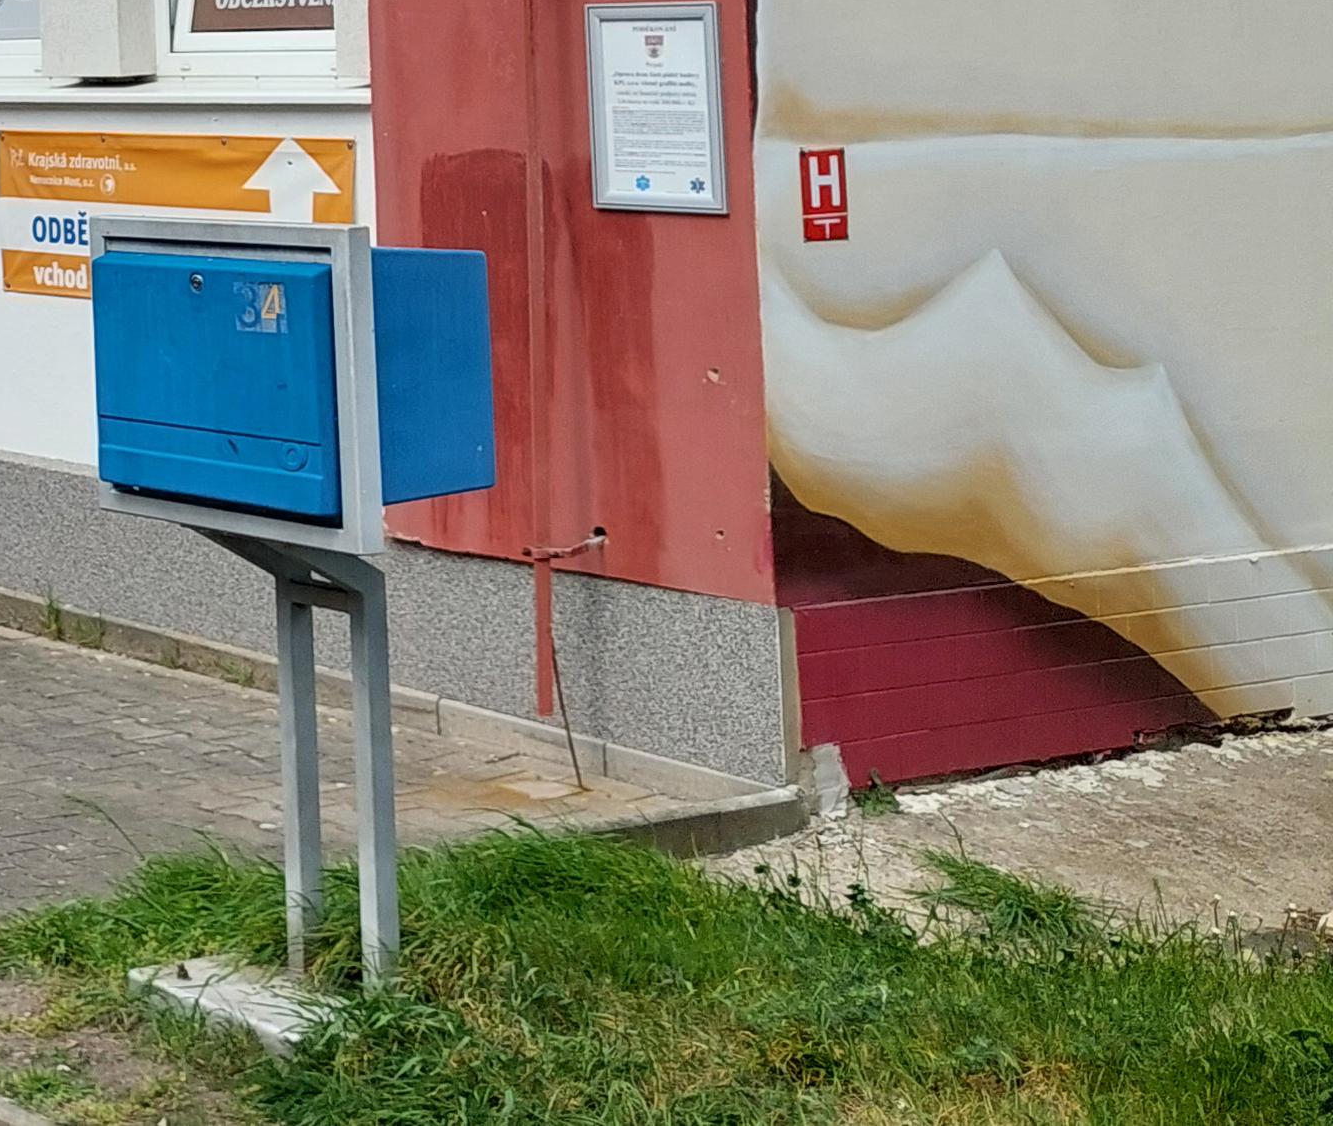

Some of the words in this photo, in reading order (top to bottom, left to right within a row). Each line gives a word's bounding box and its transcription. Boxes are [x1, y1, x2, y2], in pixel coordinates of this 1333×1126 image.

[28, 152, 67, 171] Krajská
[808, 155, 841, 208] H
[33, 261, 88, 290] vchod
